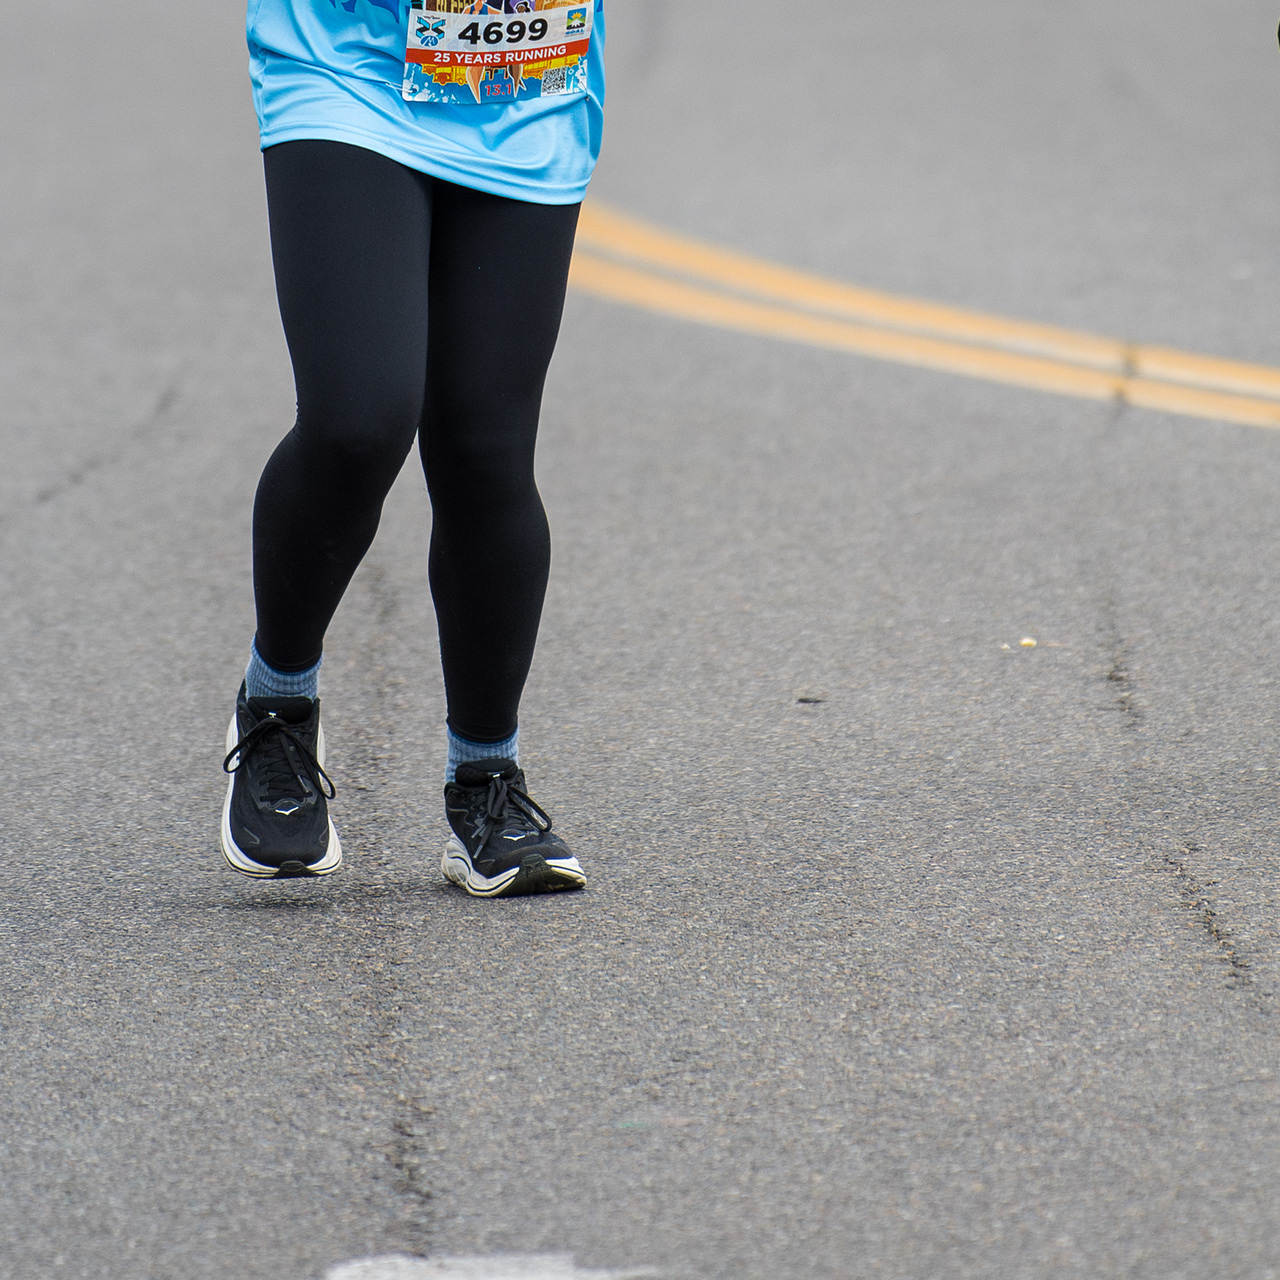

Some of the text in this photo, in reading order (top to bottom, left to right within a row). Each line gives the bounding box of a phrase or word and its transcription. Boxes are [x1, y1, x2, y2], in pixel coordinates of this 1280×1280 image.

[458, 17, 548, 45] 4699
[433, 45, 567, 64] 25 YEARS RUNNING
[484, 83, 512, 96] 13.1
